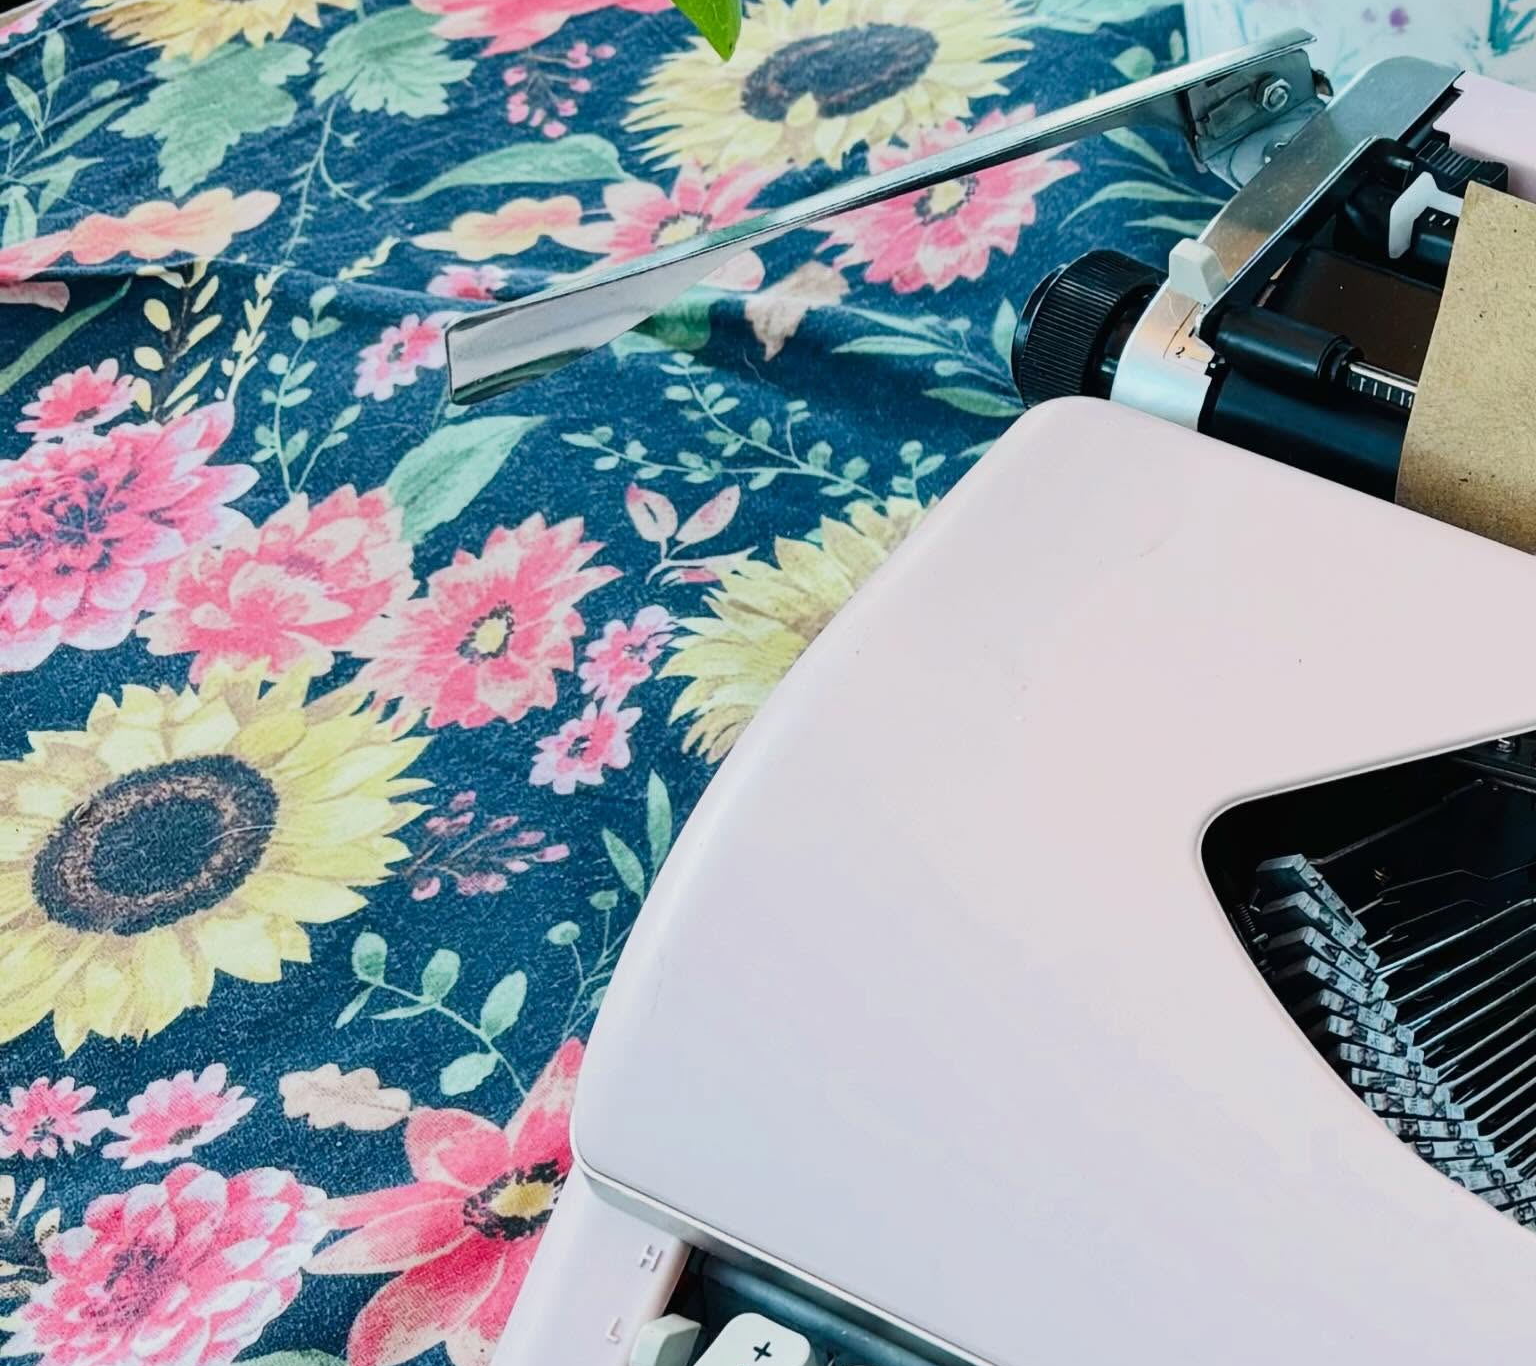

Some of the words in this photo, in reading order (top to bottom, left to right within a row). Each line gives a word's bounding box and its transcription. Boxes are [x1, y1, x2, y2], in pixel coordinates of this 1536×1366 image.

[639, 1242, 664, 1273] H
[606, 1315, 621, 1346] L
[753, 1341, 772, 1362] +
